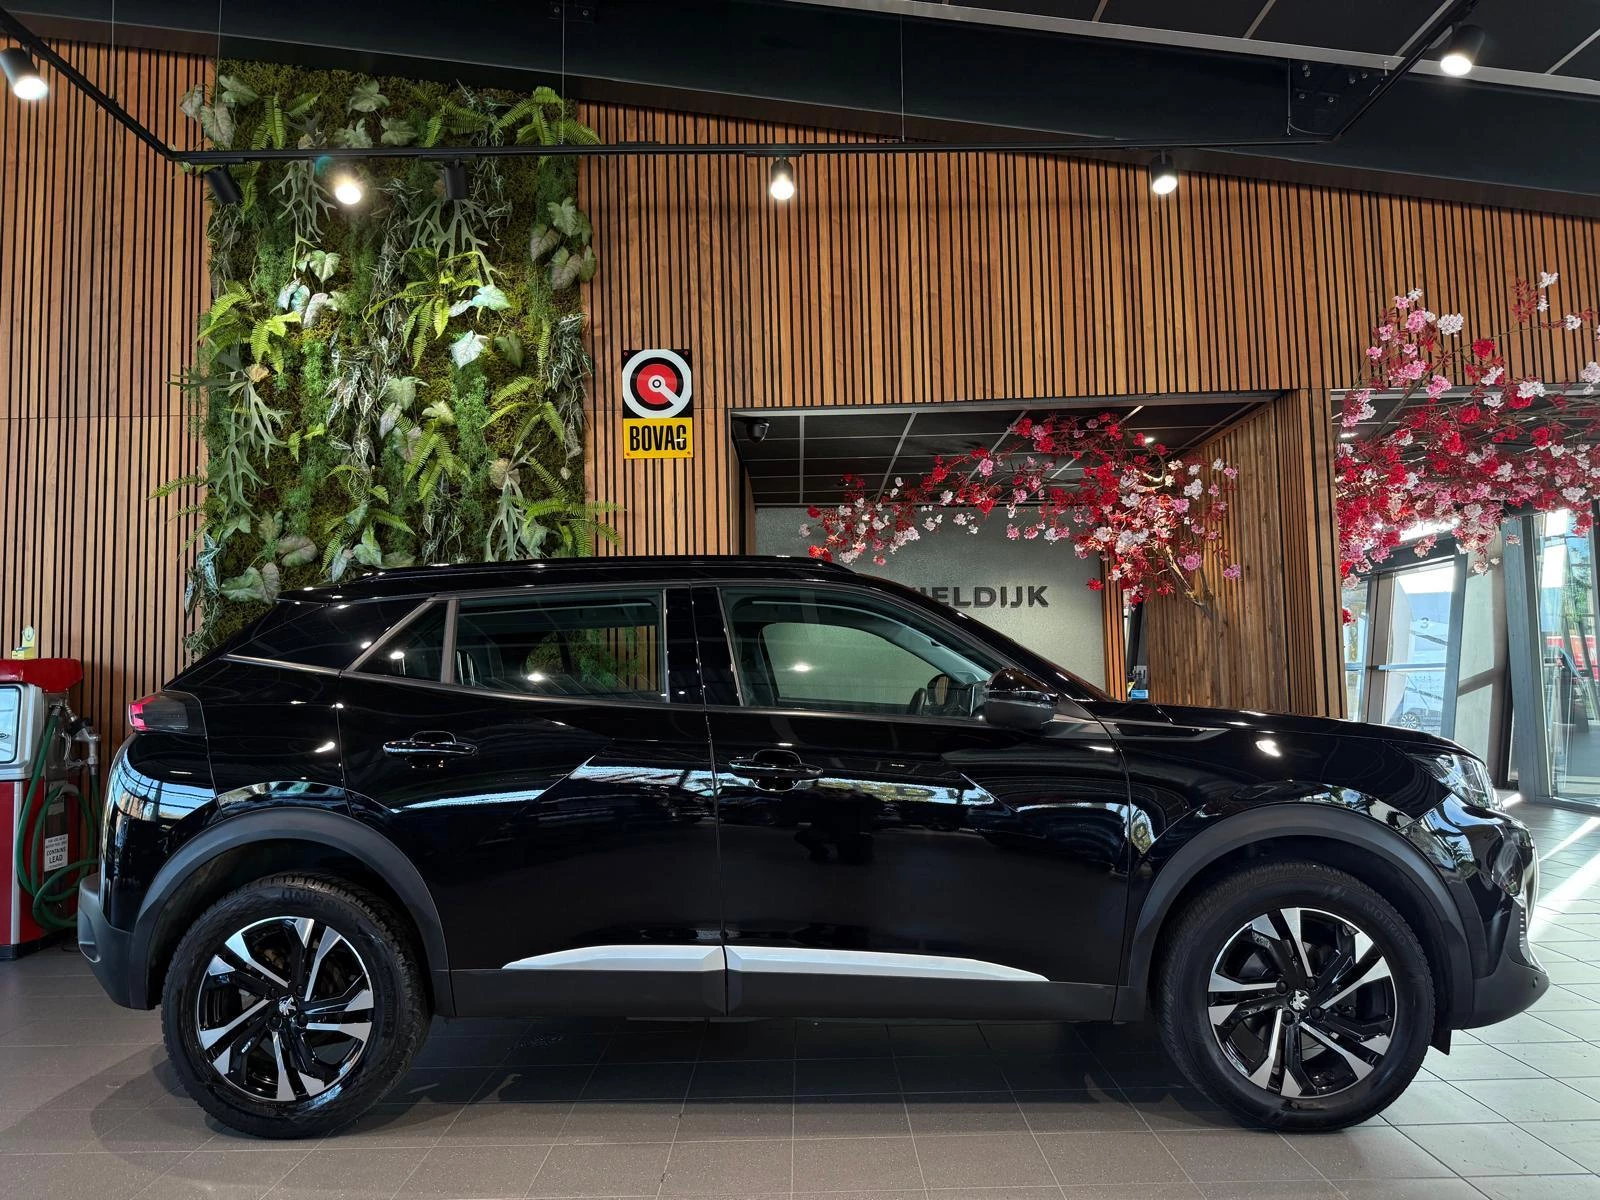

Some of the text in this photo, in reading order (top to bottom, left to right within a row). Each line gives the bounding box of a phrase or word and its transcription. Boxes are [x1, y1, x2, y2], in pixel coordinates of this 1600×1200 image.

[629, 424, 687, 452] BOVAG
[46, 846, 66, 857] CONTAINS
[49, 854, 63, 864] LEAD
[281, 889, 354, 921] UNIRO
